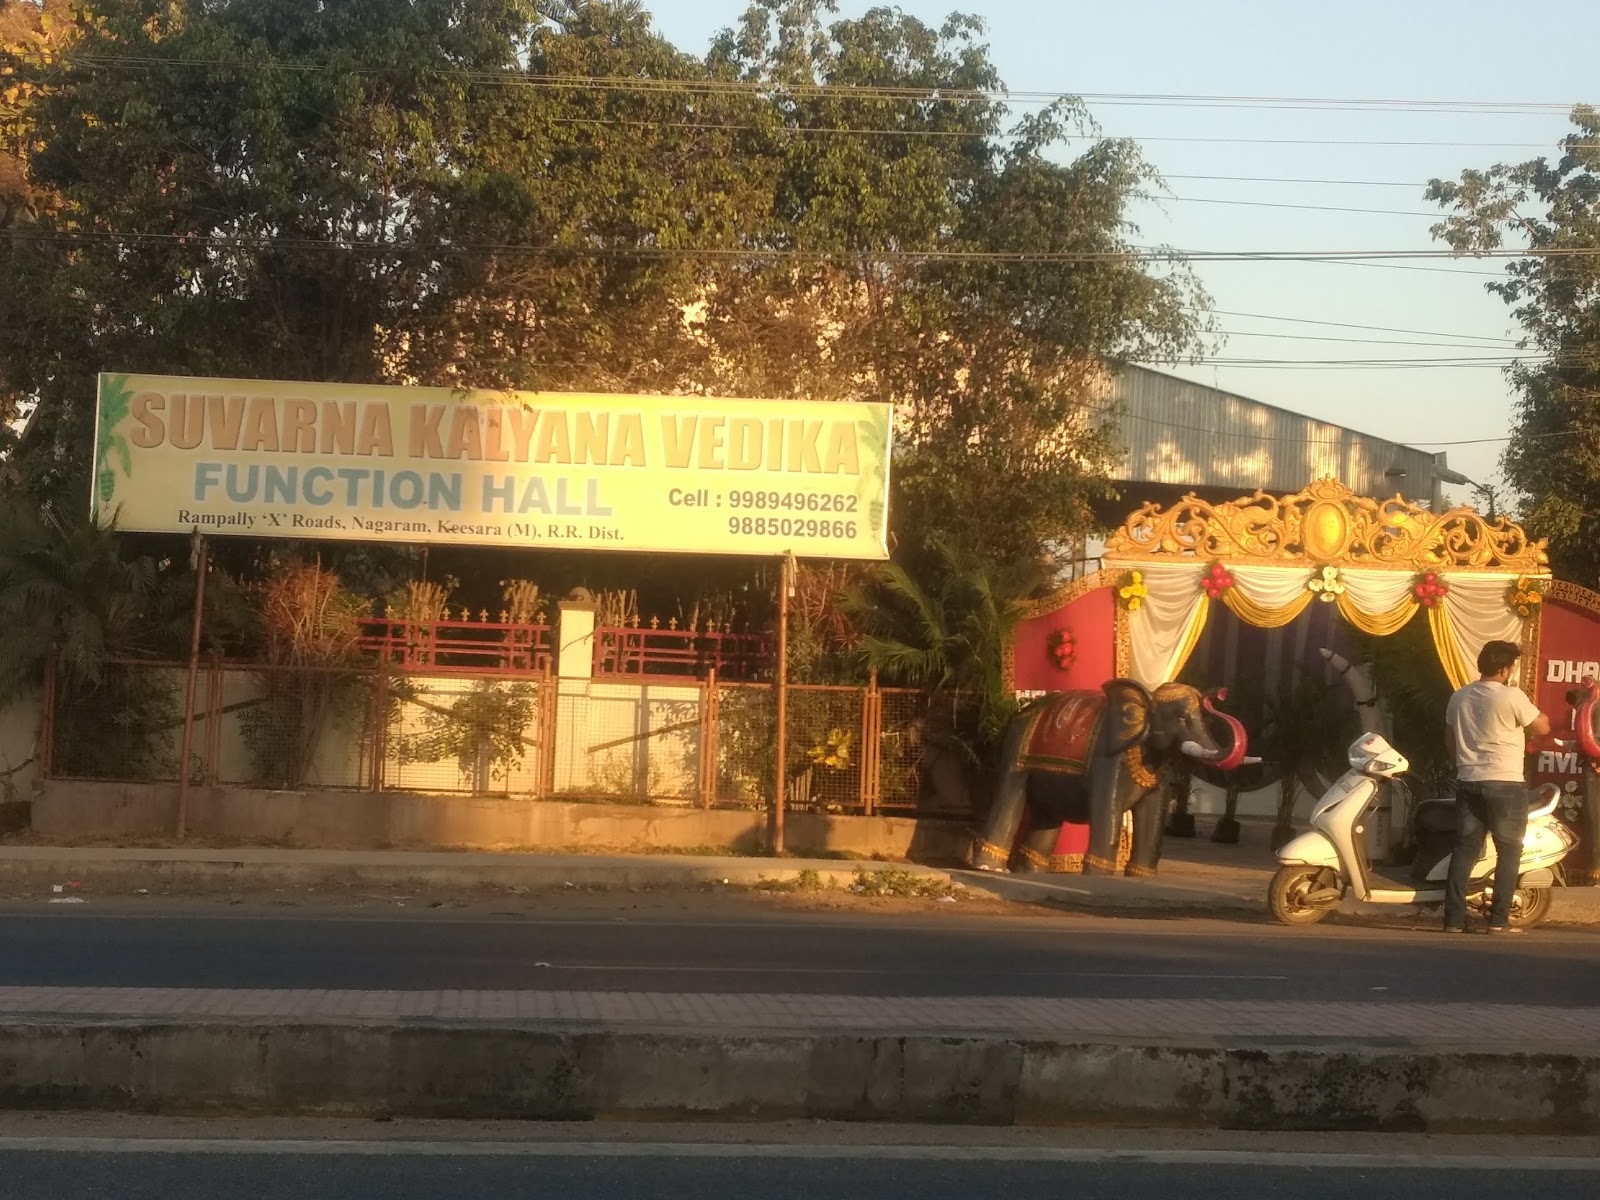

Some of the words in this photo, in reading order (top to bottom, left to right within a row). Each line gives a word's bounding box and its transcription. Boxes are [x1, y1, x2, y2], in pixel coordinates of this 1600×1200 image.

[131, 391, 394, 457] SUVARNA
[408, 404, 646, 467] KALYANA
[661, 414, 860, 475] VEDIKA
[194, 462, 461, 511] FUNCTION
[482, 475, 612, 517] HALL
[668, 488, 708, 507] Cell
[729, 490, 858, 513] 9989496262
[178, 509, 256, 529] Rampally
[292, 514, 346, 531] Roads,
[352, 516, 431, 534] Nagaram,
[437, 519, 502, 536] Keesara
[507, 521, 541, 540] (M),
[548, 524, 583, 539] R.R.
[589, 525, 624, 541] Dist.
[728, 516, 857, 539] 9885029866
[1546, 659, 1600, 684] DHA
